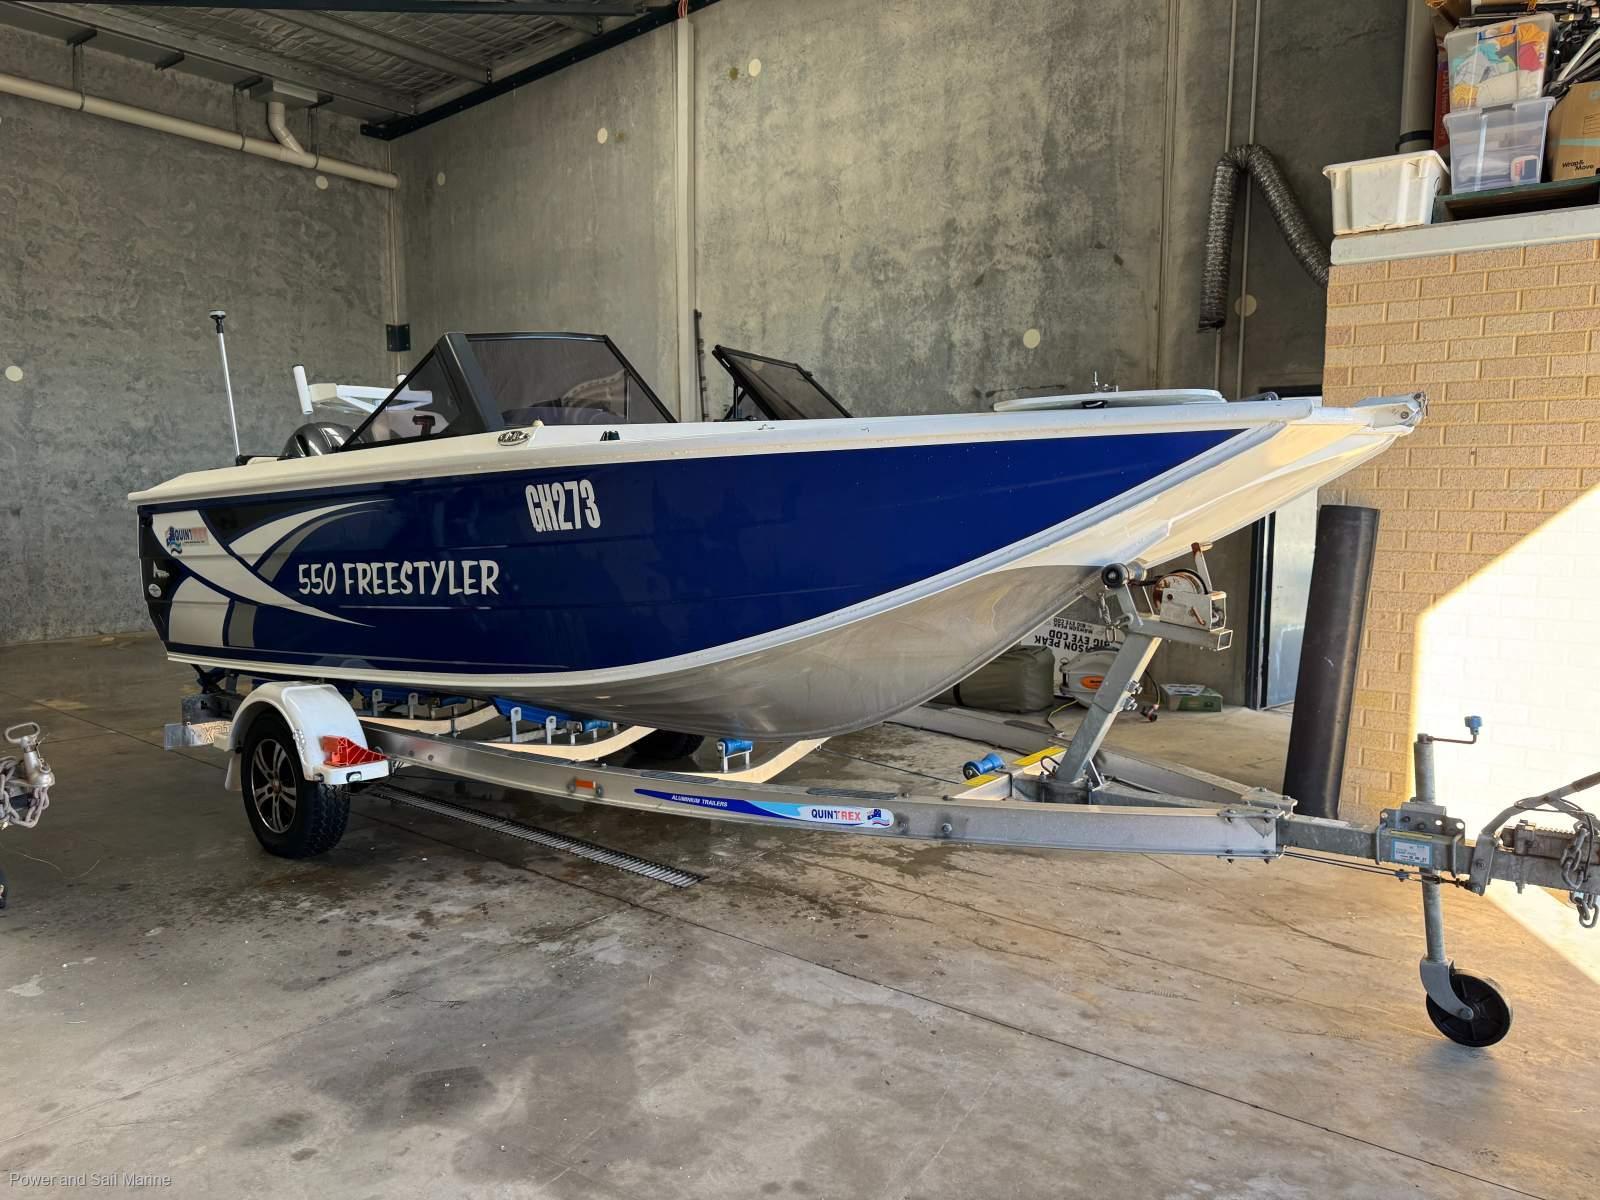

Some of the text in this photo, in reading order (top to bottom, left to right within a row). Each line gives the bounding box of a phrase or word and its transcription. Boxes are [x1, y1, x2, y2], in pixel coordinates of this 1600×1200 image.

[298, 560, 499, 595] 550 FREESTYLER
[1034, 635, 1061, 648] PEAK
[1048, 629, 1069, 641] COD
[1071, 633, 1090, 645] EYE
[671, 795, 728, 808] ALUMINIUM TRAILERS
[811, 808, 861, 821] QUINTREX
